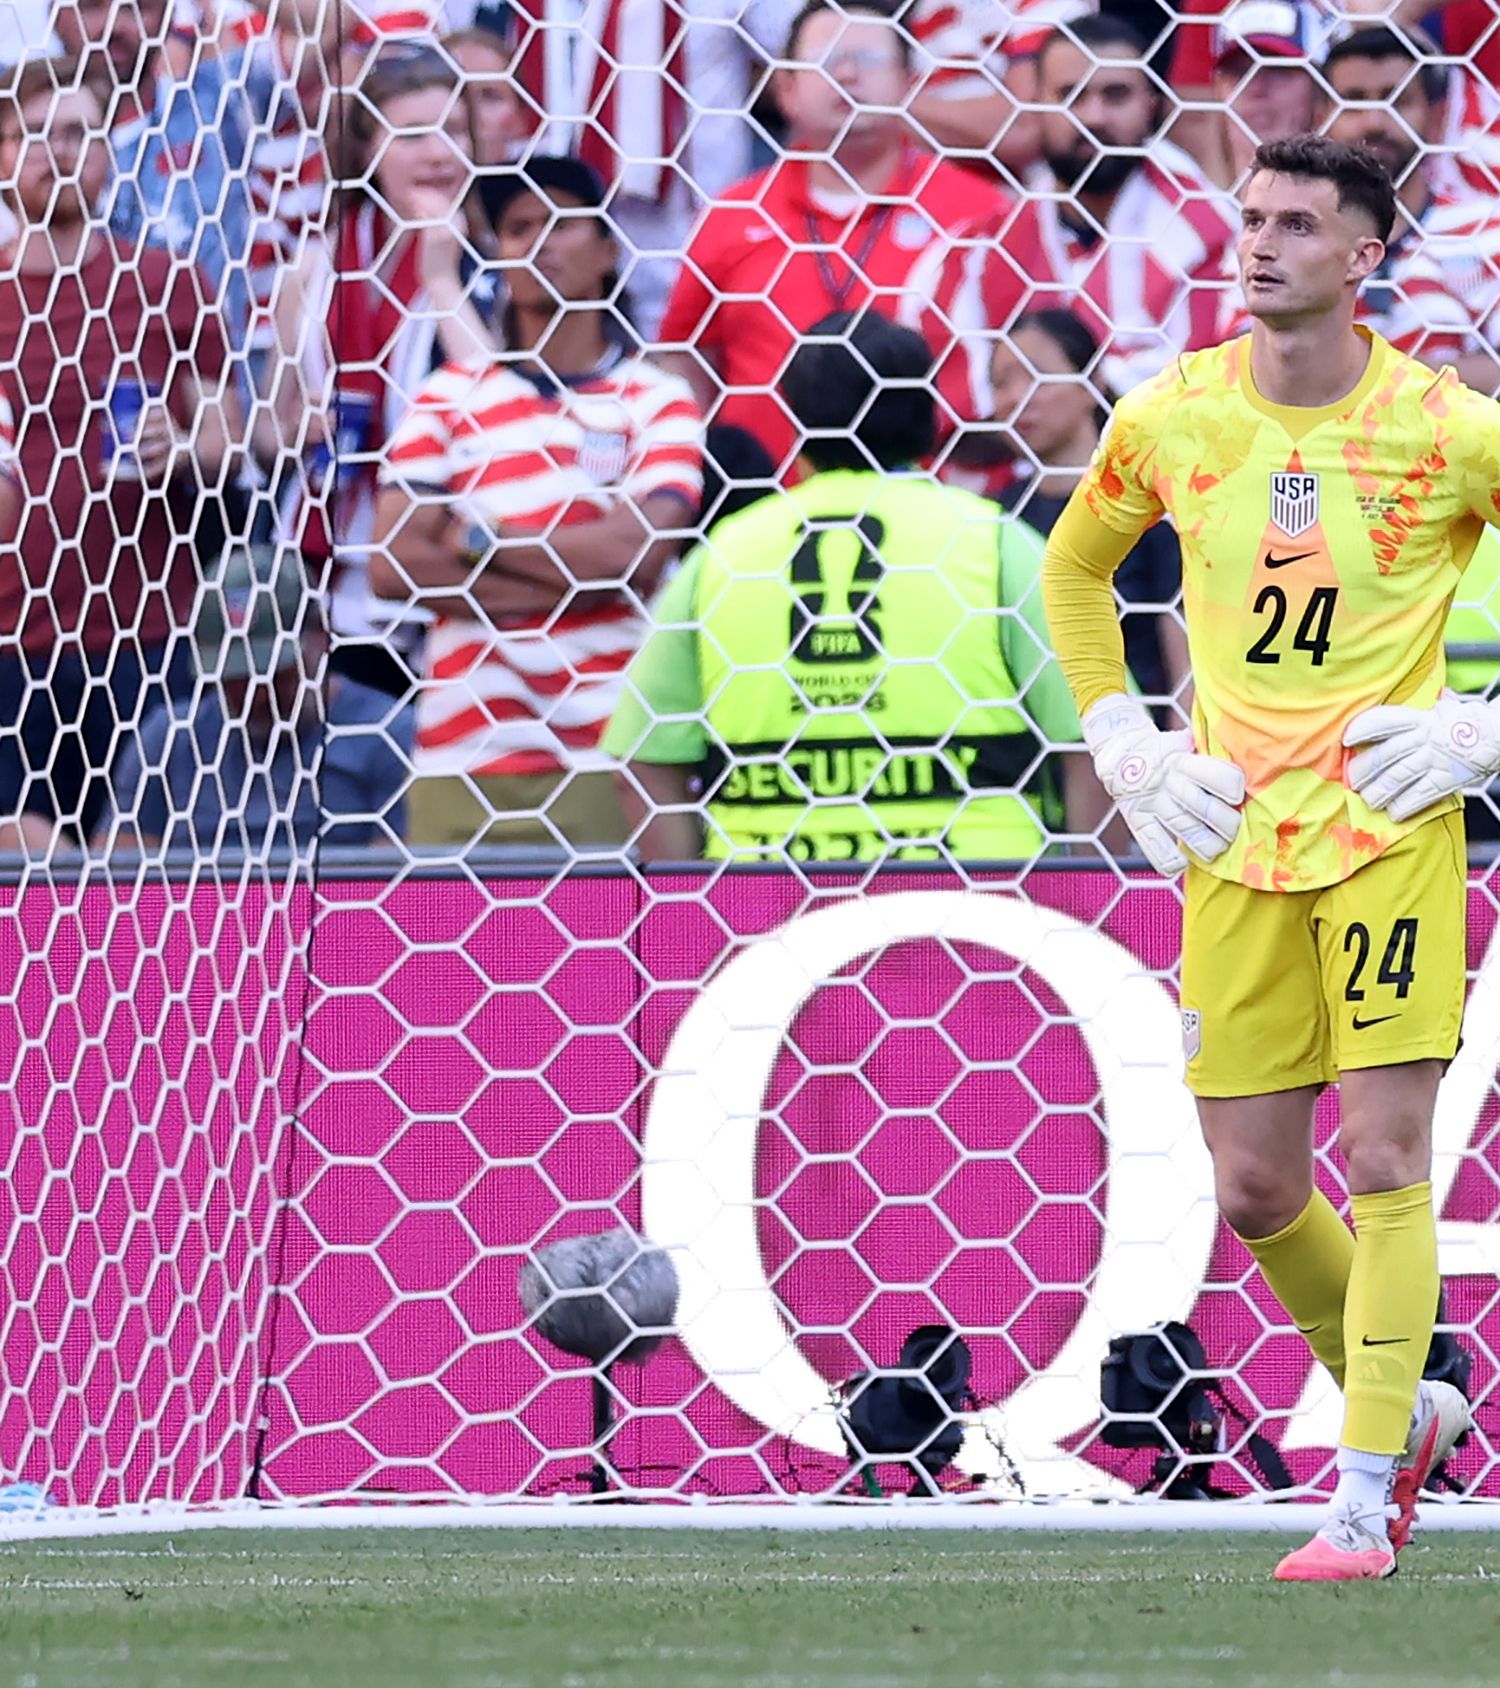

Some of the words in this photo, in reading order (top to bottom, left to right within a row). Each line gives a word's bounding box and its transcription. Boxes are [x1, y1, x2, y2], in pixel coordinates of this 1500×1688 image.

[1274, 476, 1315, 501] USA
[1245, 584, 1339, 667] 24
[721, 746, 979, 799] SECURITY
[1343, 917, 1419, 1001] 24
